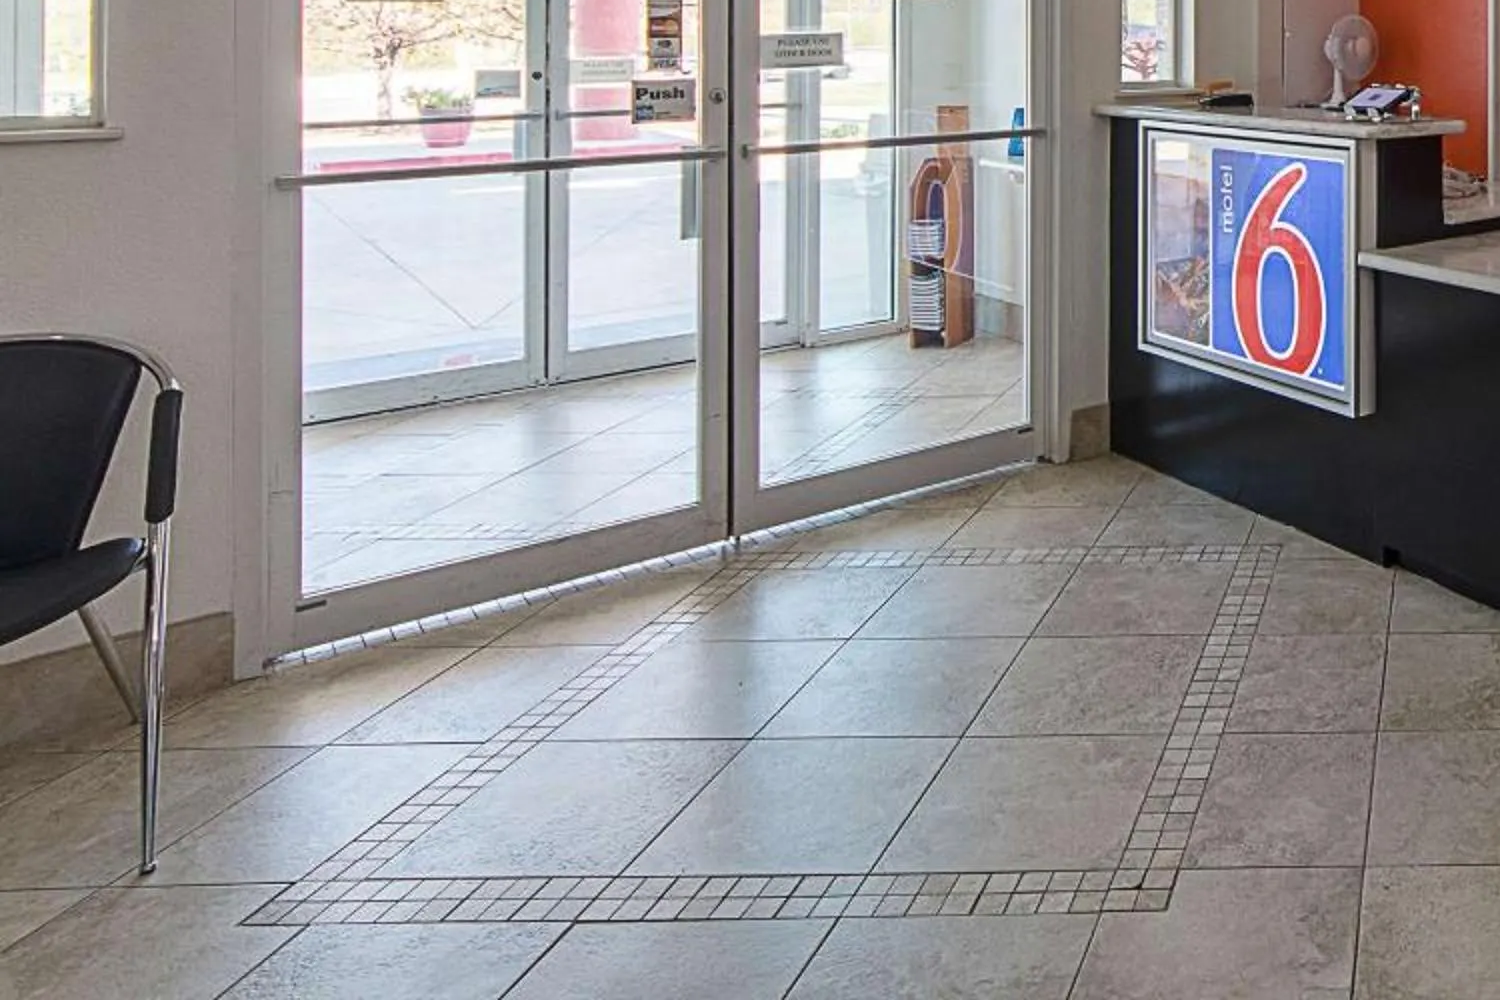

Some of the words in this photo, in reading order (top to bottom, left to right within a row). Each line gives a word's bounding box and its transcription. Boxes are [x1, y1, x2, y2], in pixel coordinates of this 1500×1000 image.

[635, 86, 685, 100] Push
[1220, 165, 1233, 233] motel
[1231, 161, 1327, 377] 6
